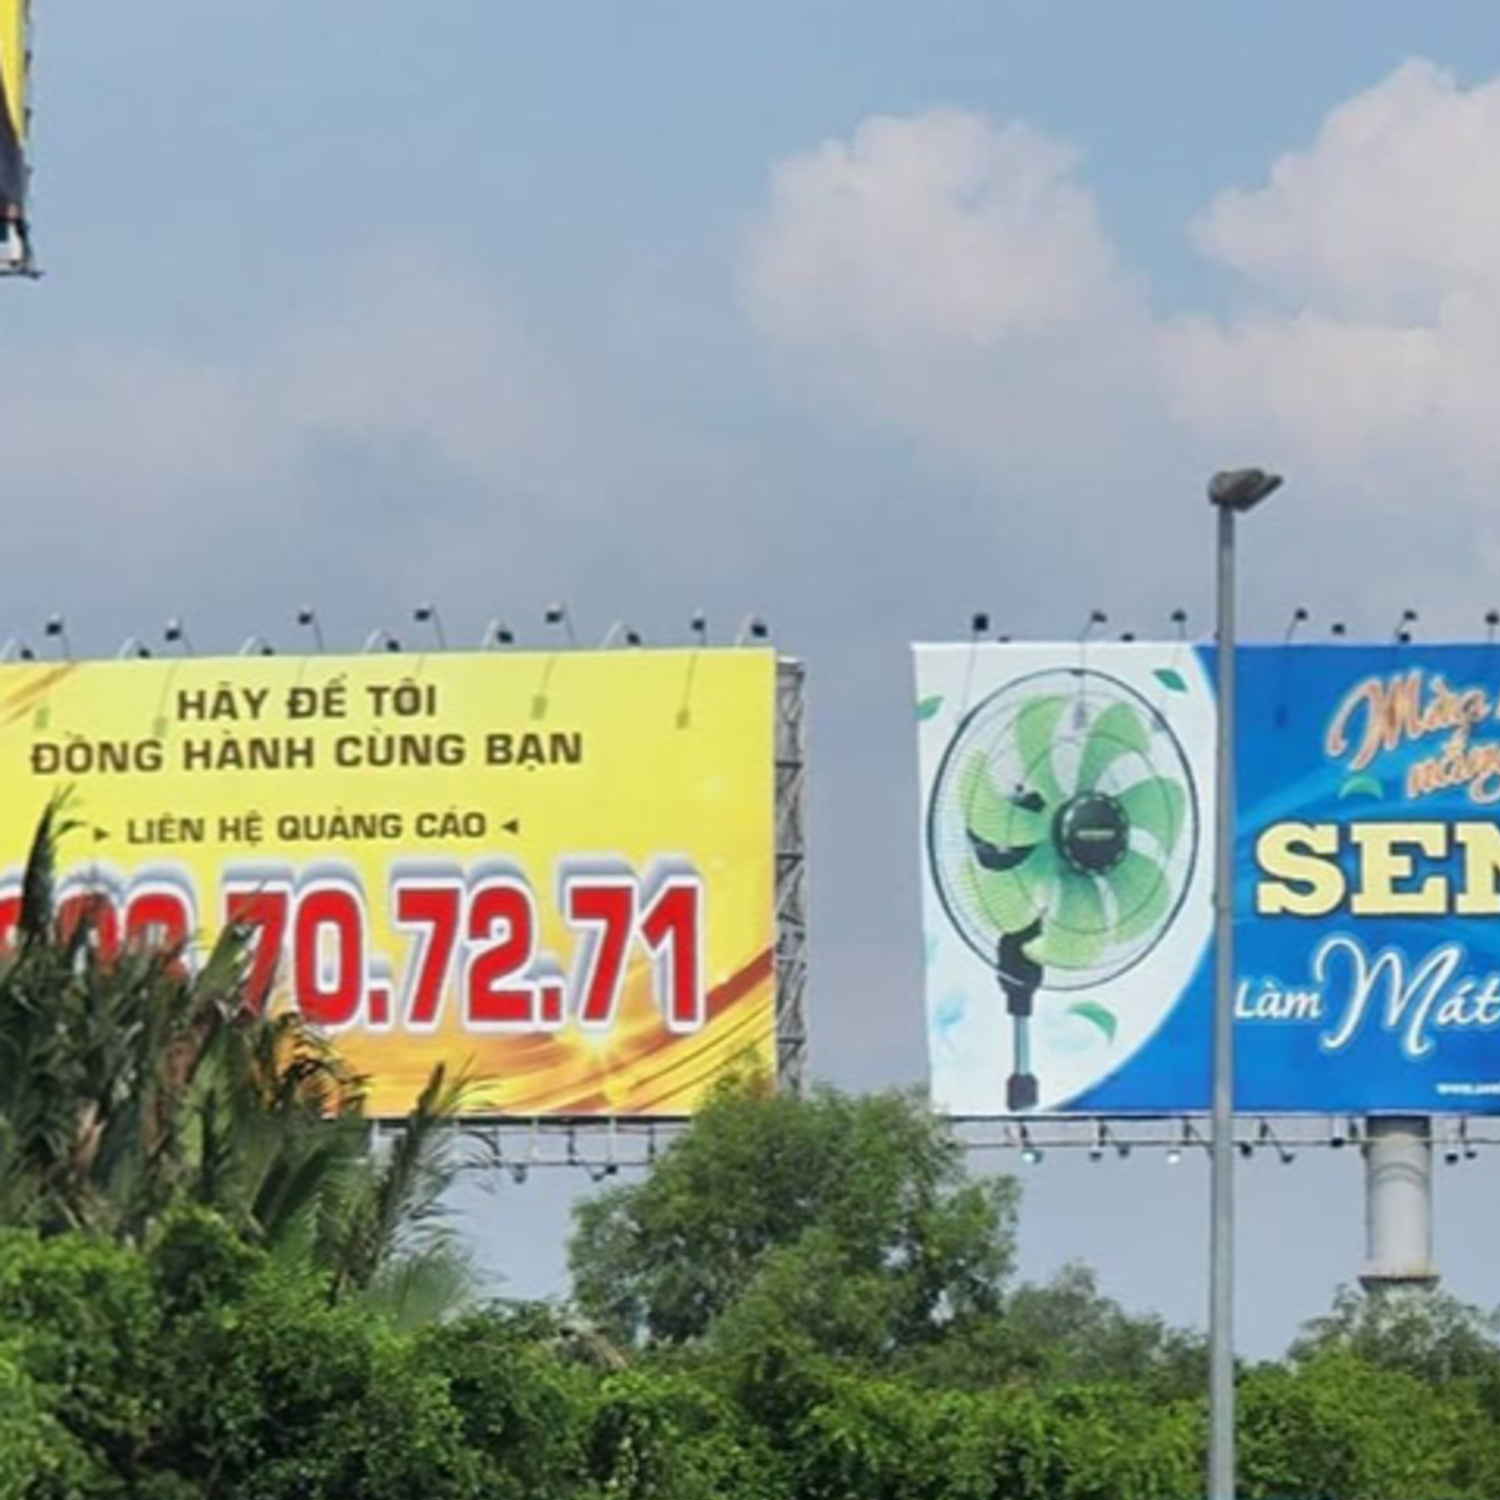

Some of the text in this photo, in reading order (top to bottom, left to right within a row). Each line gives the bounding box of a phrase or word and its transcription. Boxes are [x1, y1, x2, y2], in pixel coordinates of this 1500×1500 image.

[177, 682, 268, 721] HÃY
[367, 679, 437, 718] TÔI
[31, 725, 582, 775] ĐỒNG HÀNH CÙNG BẠN
[127, 809, 487, 849] LIÊN HỆ QUẢNG CÁO
[1234, 980, 1322, 1020] Làm
